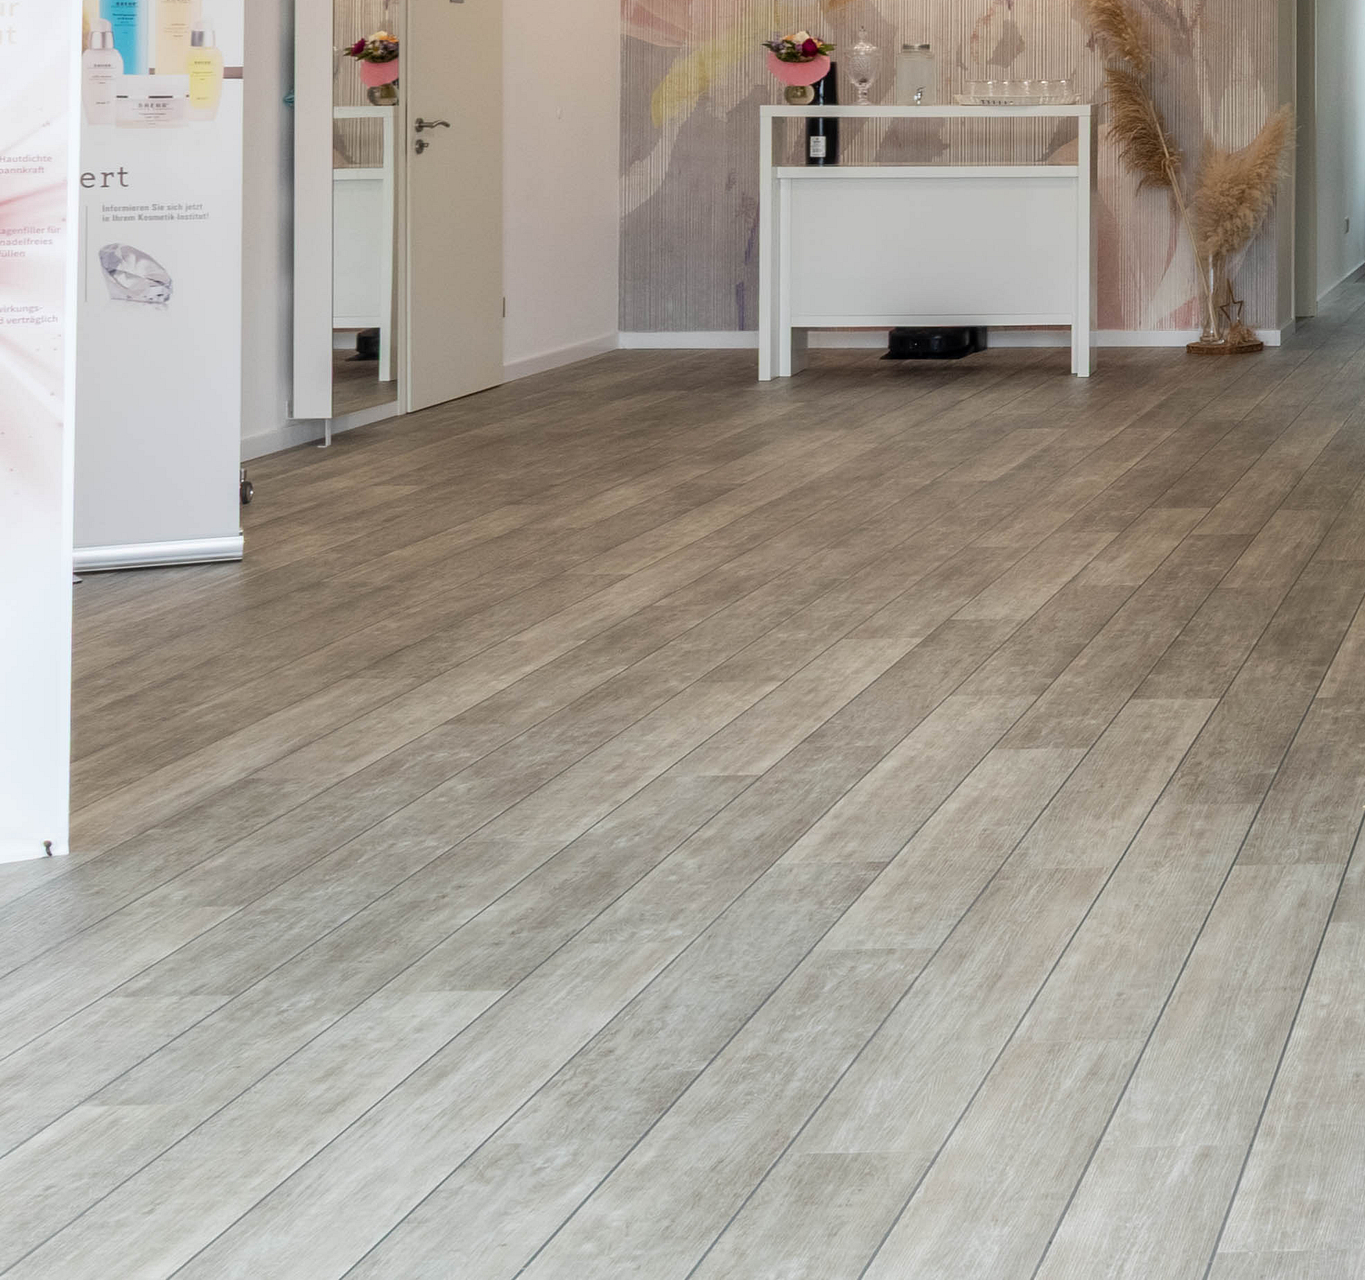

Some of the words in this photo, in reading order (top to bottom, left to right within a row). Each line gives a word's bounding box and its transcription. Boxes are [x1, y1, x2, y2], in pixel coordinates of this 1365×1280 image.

[102, 204, 149, 212] Informieren
[152, 203, 164, 211] Sie
[47, 225, 61, 234] für
[6, 314, 58, 324] verträglich
